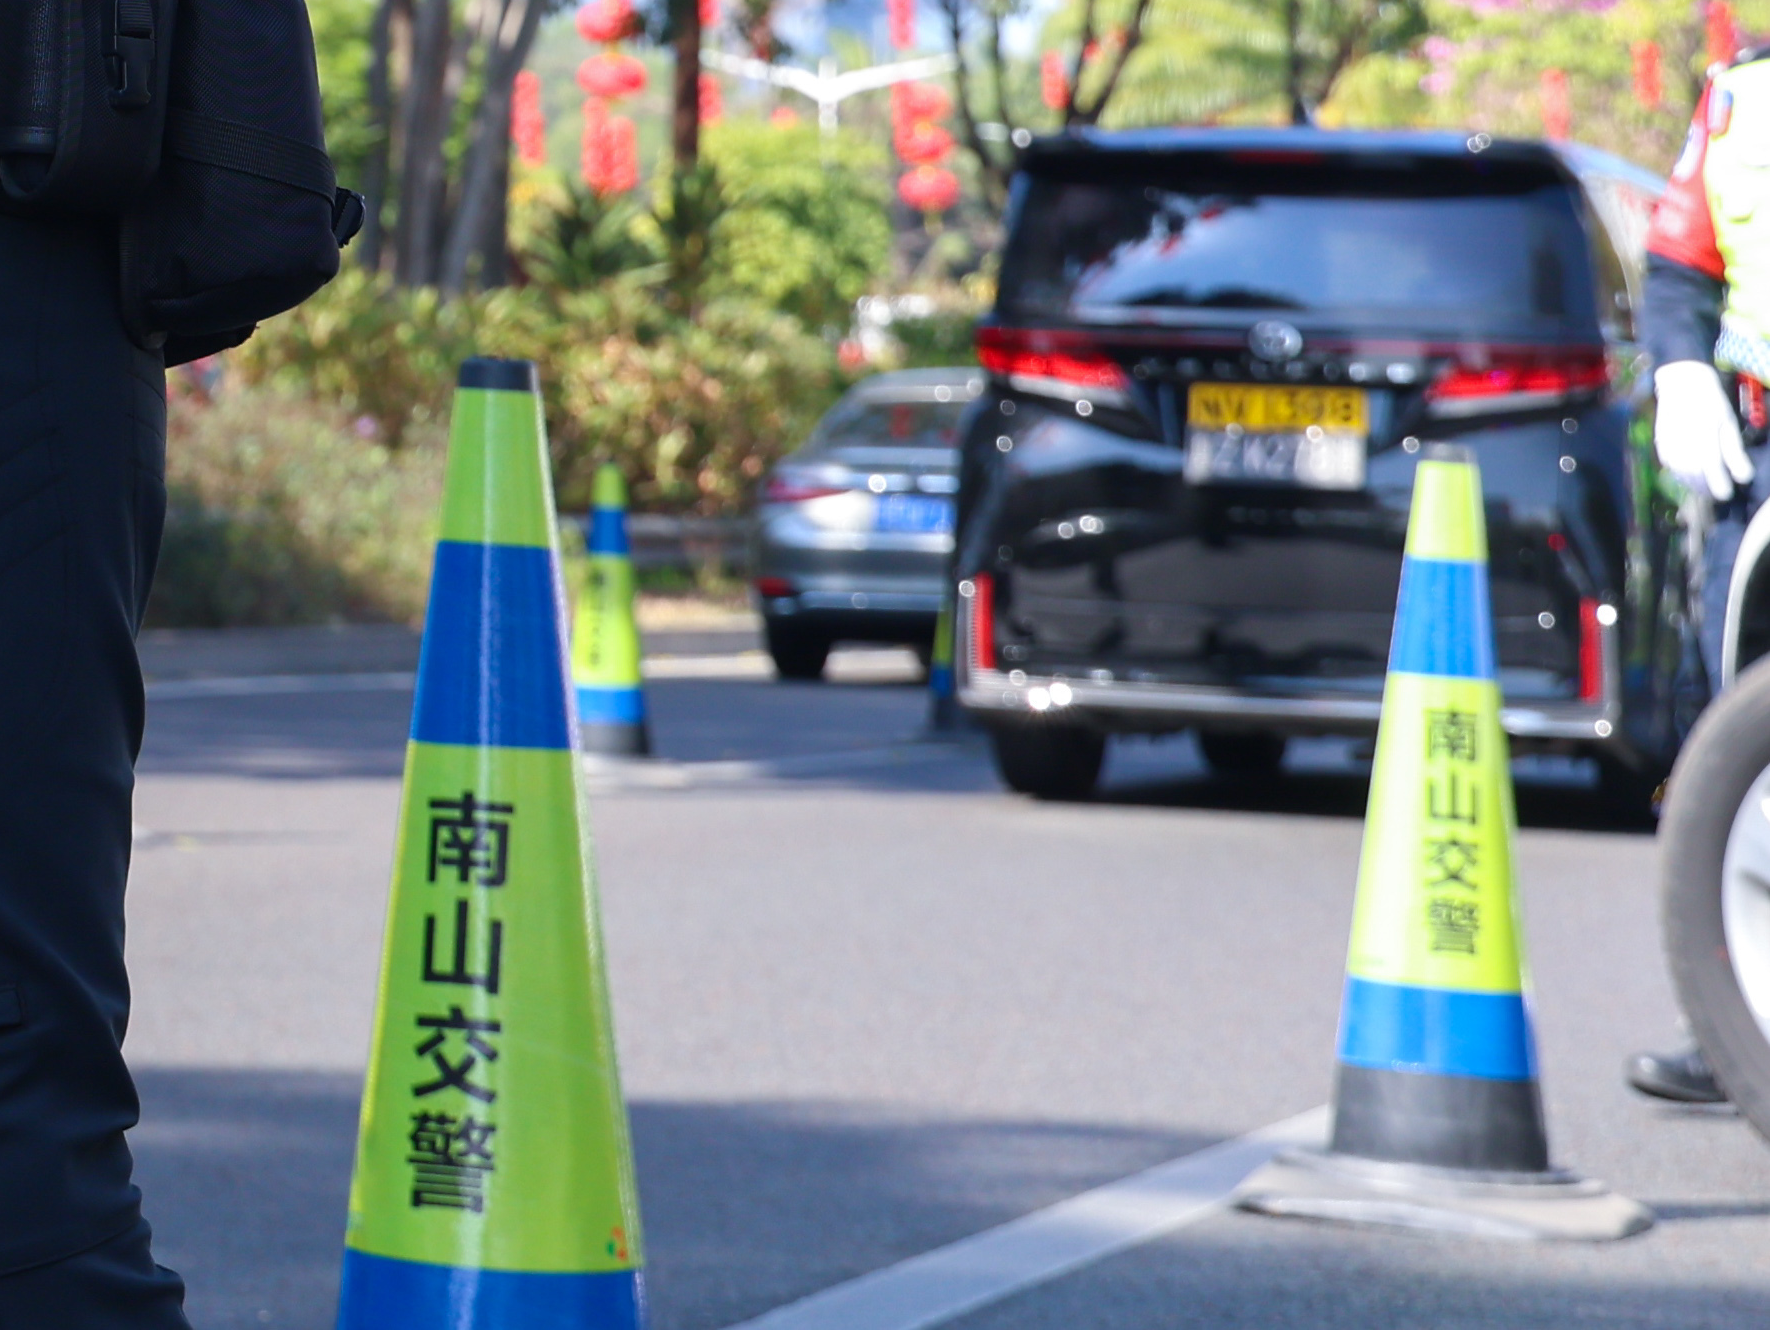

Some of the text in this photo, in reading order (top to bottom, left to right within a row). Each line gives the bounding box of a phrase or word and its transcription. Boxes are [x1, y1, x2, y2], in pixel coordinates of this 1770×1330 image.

[1428, 706, 1479, 954] 南山交警
[406, 792, 514, 1214] 南山交警
